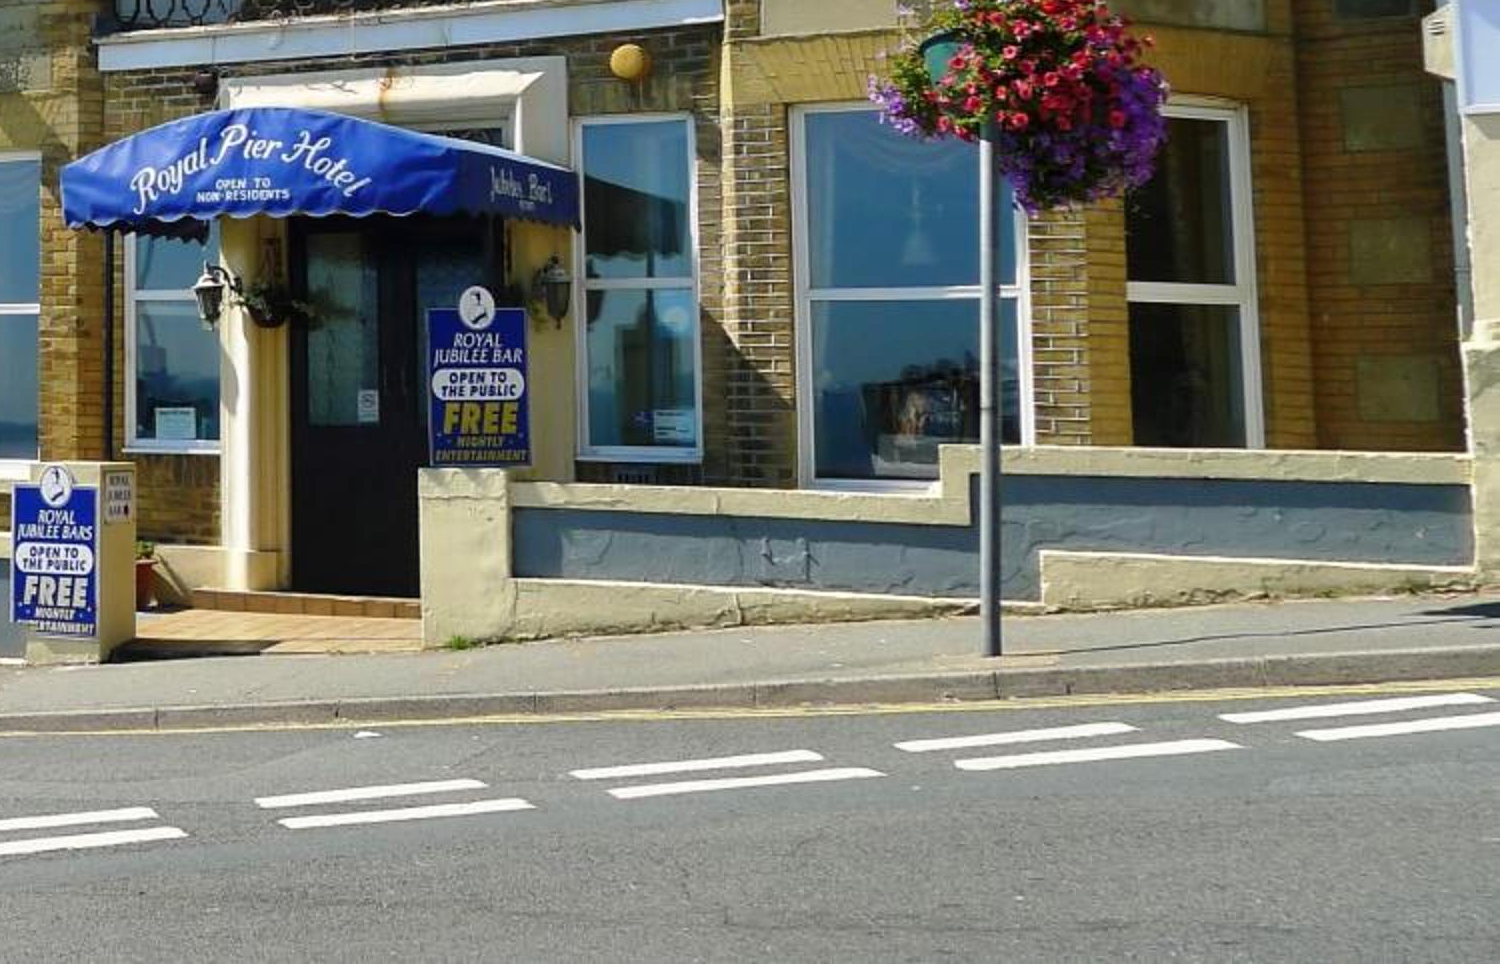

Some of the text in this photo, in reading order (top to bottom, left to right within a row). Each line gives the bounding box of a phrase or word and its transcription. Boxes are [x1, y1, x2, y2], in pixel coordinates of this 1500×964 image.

[130, 123, 372, 215] Royal Pier Hotel
[215, 177, 271, 190] OPEN TO
[196, 188, 290, 203] NON-RESIDENTS
[453, 333, 502, 348] ROYAL
[434, 348, 523, 367] JUBILEE BAR
[450, 372, 507, 384] OPEN TO
[441, 384, 517, 397] THE PUBLIC
[443, 402, 520, 435] FREE
[435, 449, 528, 461] ENTERTAINMENT
[37, 509, 77, 525] ROYAL
[18, 523, 93, 540] JUBILEE BARS
[29, 546, 79, 558] OPEN TO
[23, 559, 86, 571] THE PUBLIC
[23, 575, 89, 608] FREE
